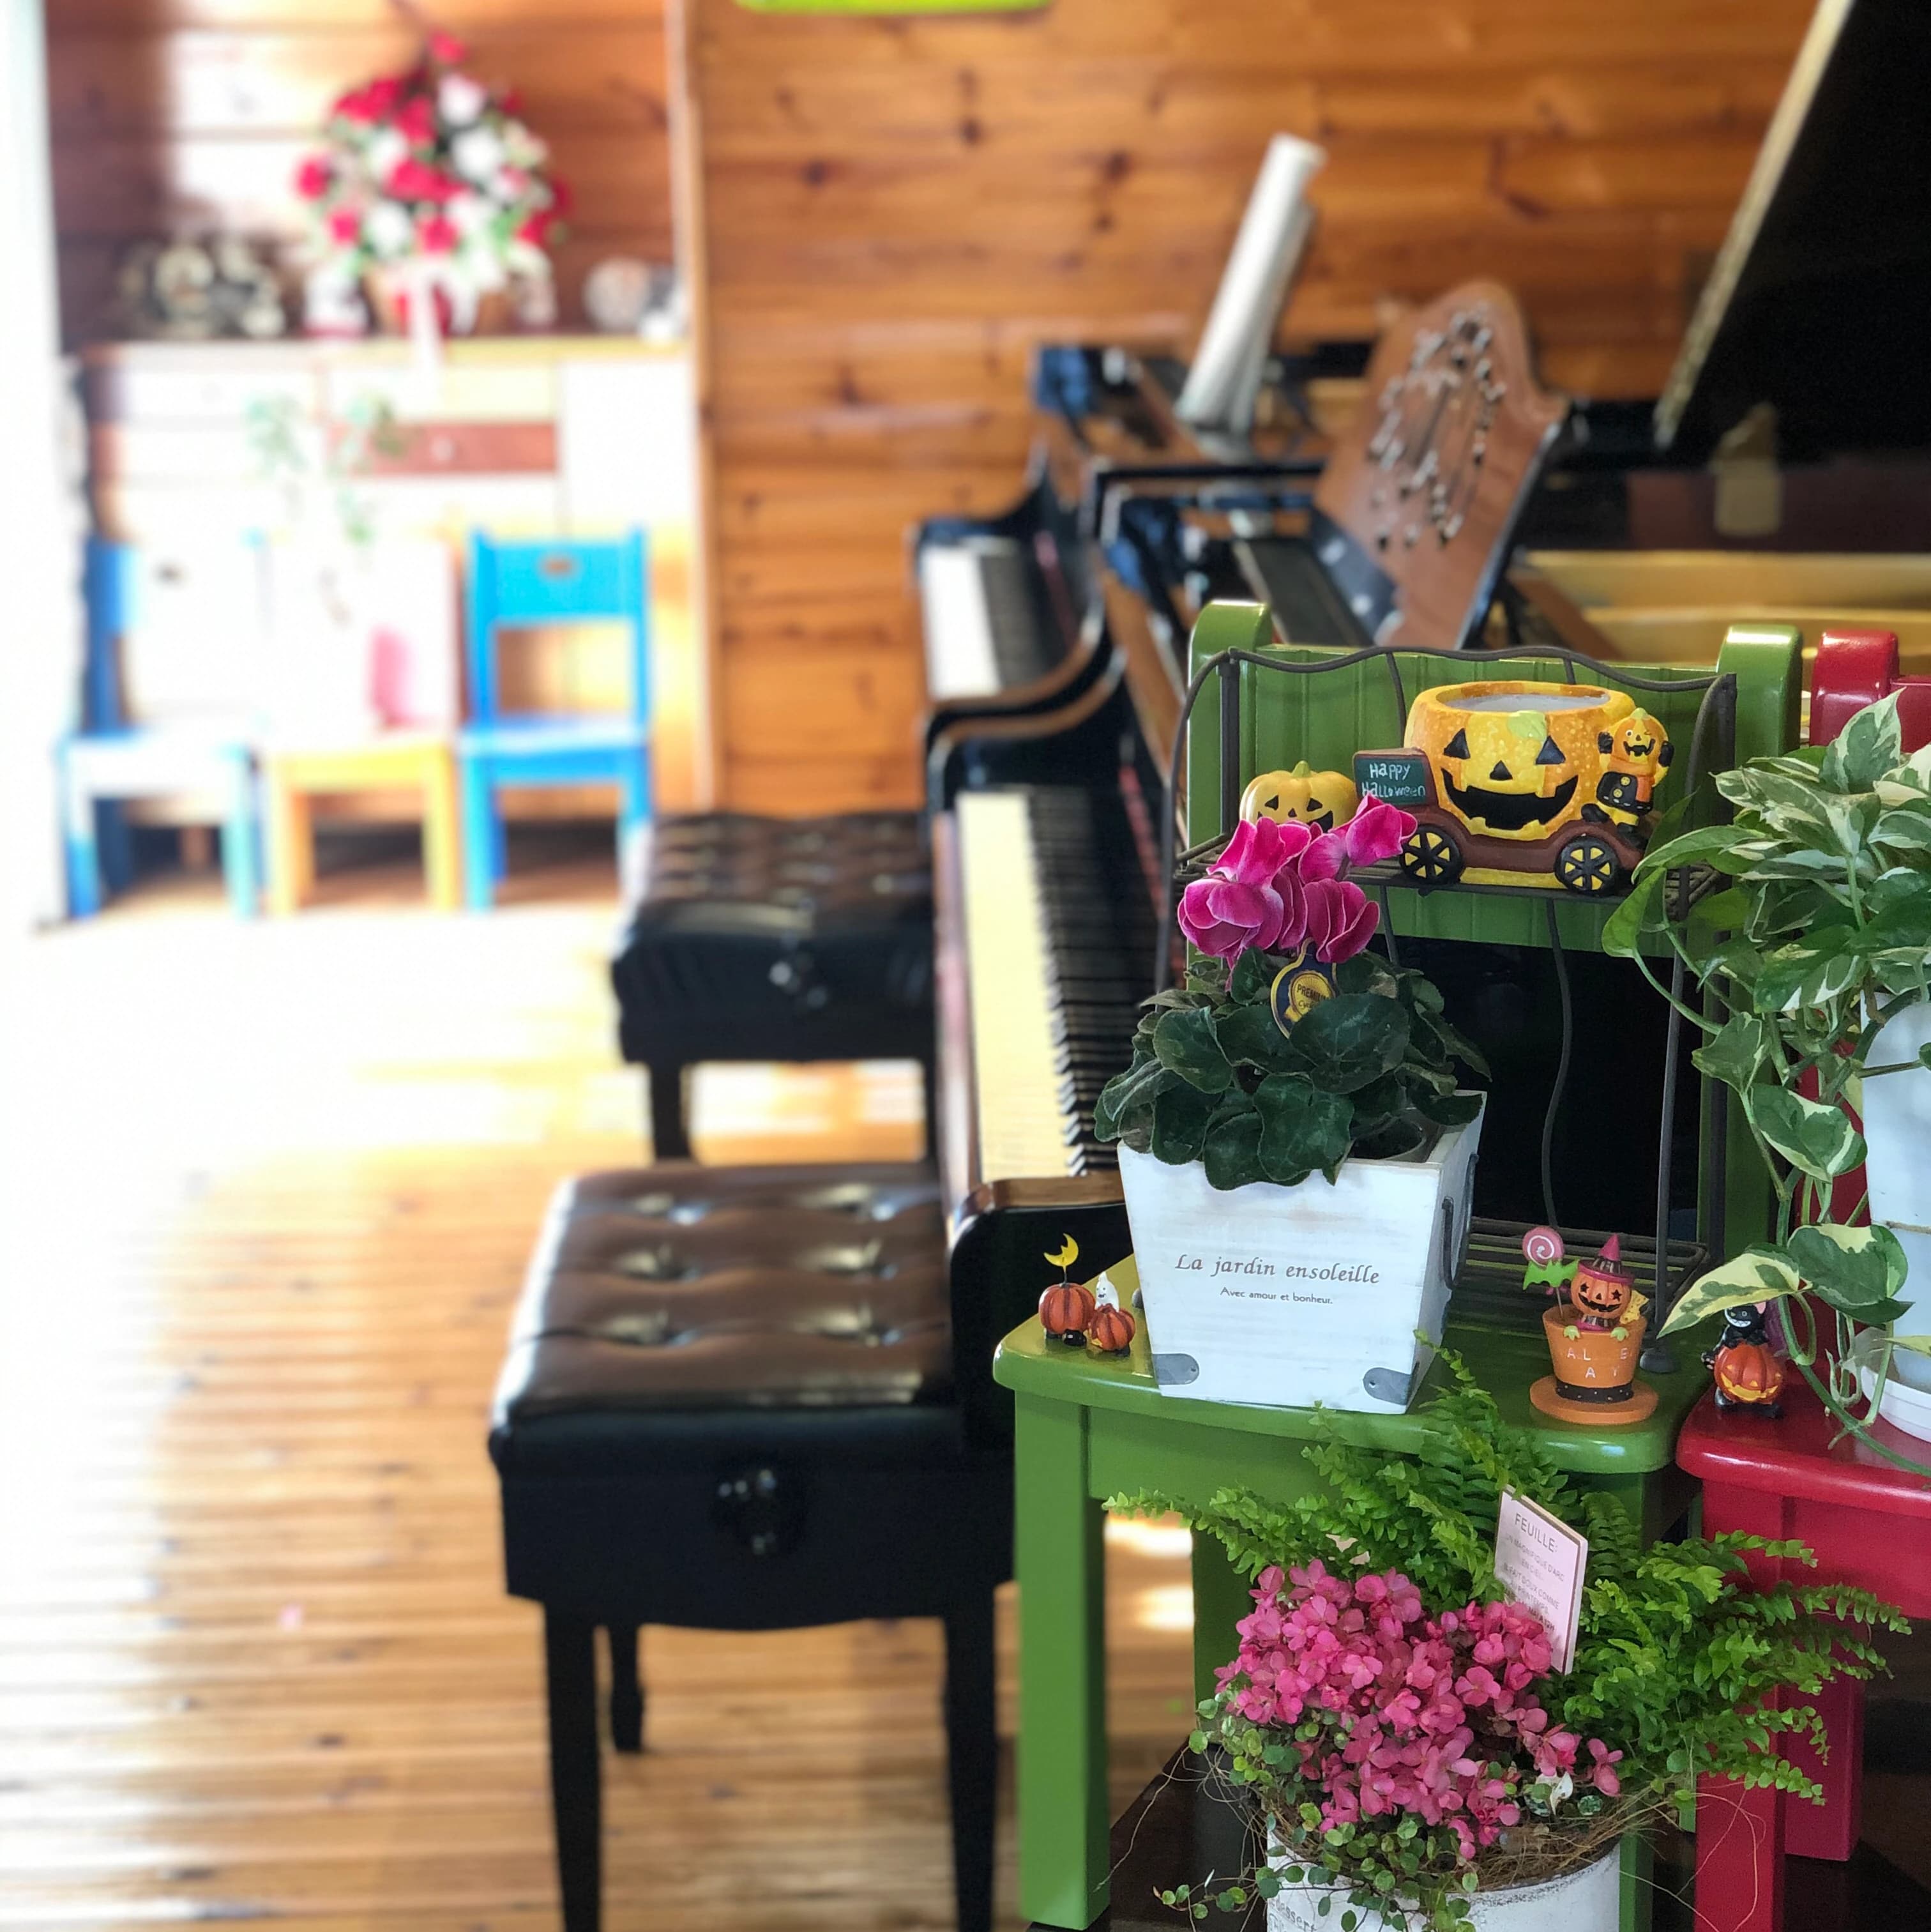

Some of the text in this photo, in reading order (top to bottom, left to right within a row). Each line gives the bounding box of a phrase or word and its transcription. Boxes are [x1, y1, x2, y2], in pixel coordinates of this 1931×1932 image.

[1369, 763, 1410, 780] Happy
[1361, 782, 1426, 797] Halloween
[1175, 1254, 1379, 1284] La jardin ensoleille
[1220, 1286, 1245, 1298] Avec
[1248, 1292, 1276, 1300] amour
[1293, 1292, 1333, 1304] bonheur.
